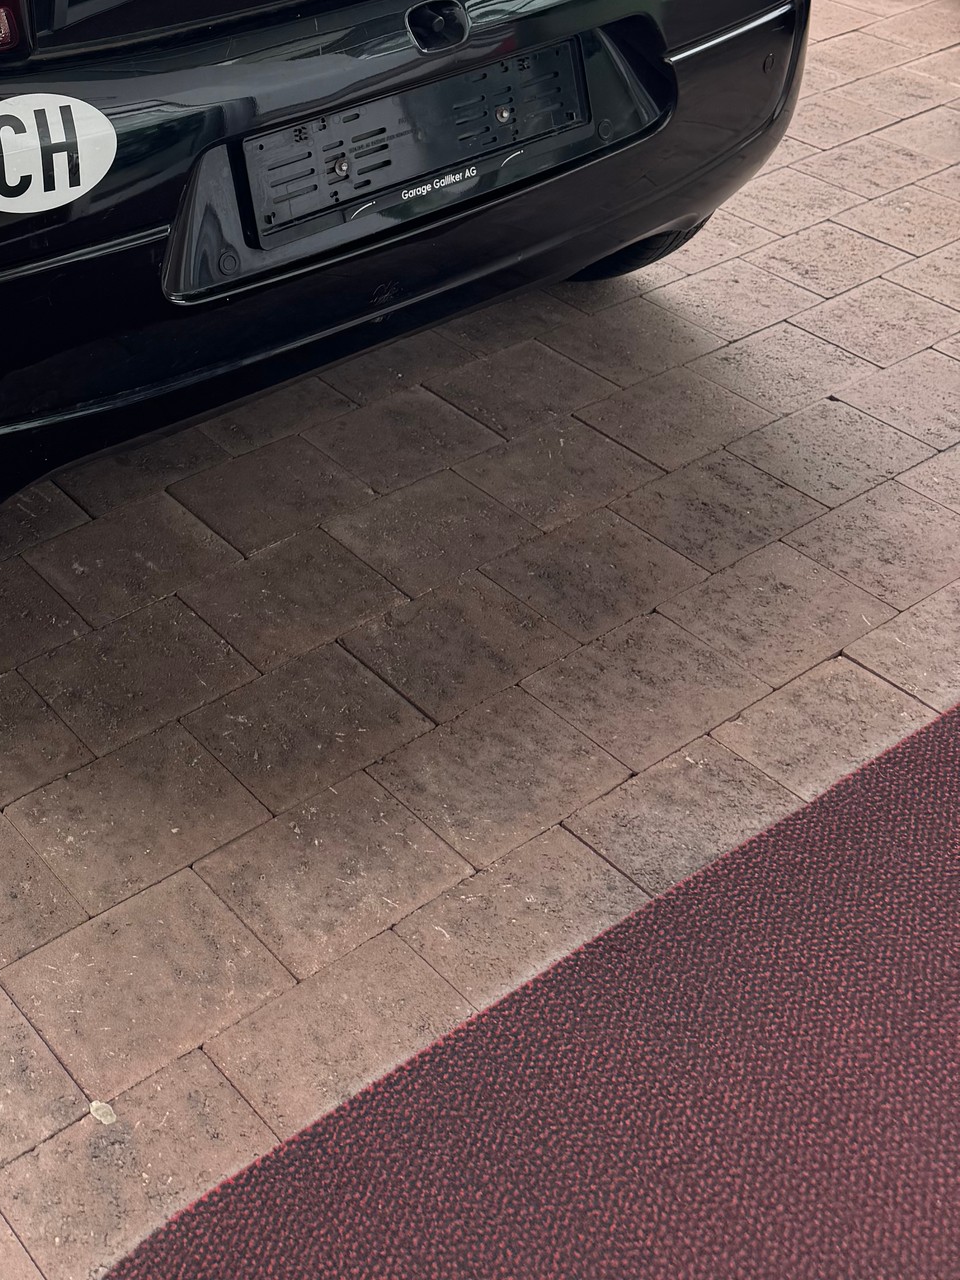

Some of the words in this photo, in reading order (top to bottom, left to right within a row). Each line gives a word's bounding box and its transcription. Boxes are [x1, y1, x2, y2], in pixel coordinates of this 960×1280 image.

[401, 183, 432, 200] Garage
[433, 172, 463, 189] Galliker
[464, 166, 477, 179] AG
